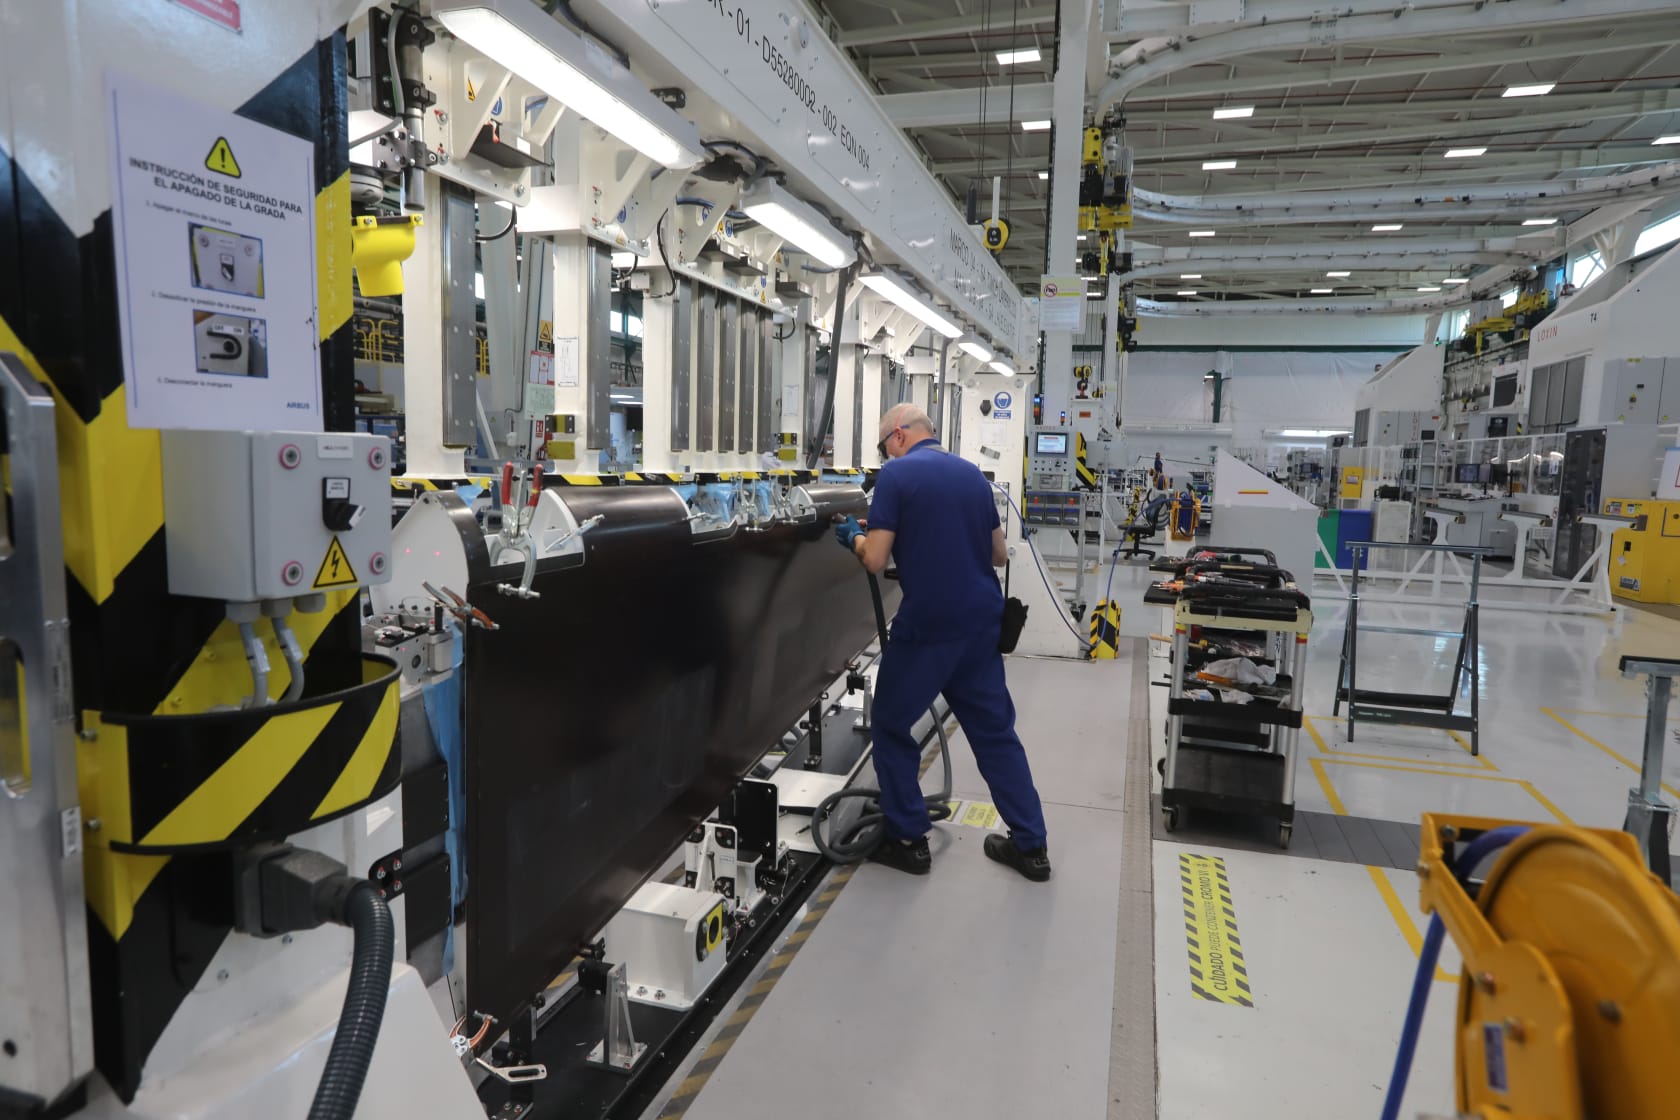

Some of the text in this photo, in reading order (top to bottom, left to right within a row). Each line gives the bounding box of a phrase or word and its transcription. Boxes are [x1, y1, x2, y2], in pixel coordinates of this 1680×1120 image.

[736, 8, 750, 44] 01
[763, 34, 815, 114] D55280002
[822, 105, 837, 136] 002
[129, 157, 303, 214] INSTRUCCIÓN DE SEGURIDAD PARA
[154, 176, 286, 220] EL APAGADO DE LA GRADA
[286, 402, 310, 410] AIRBUS
